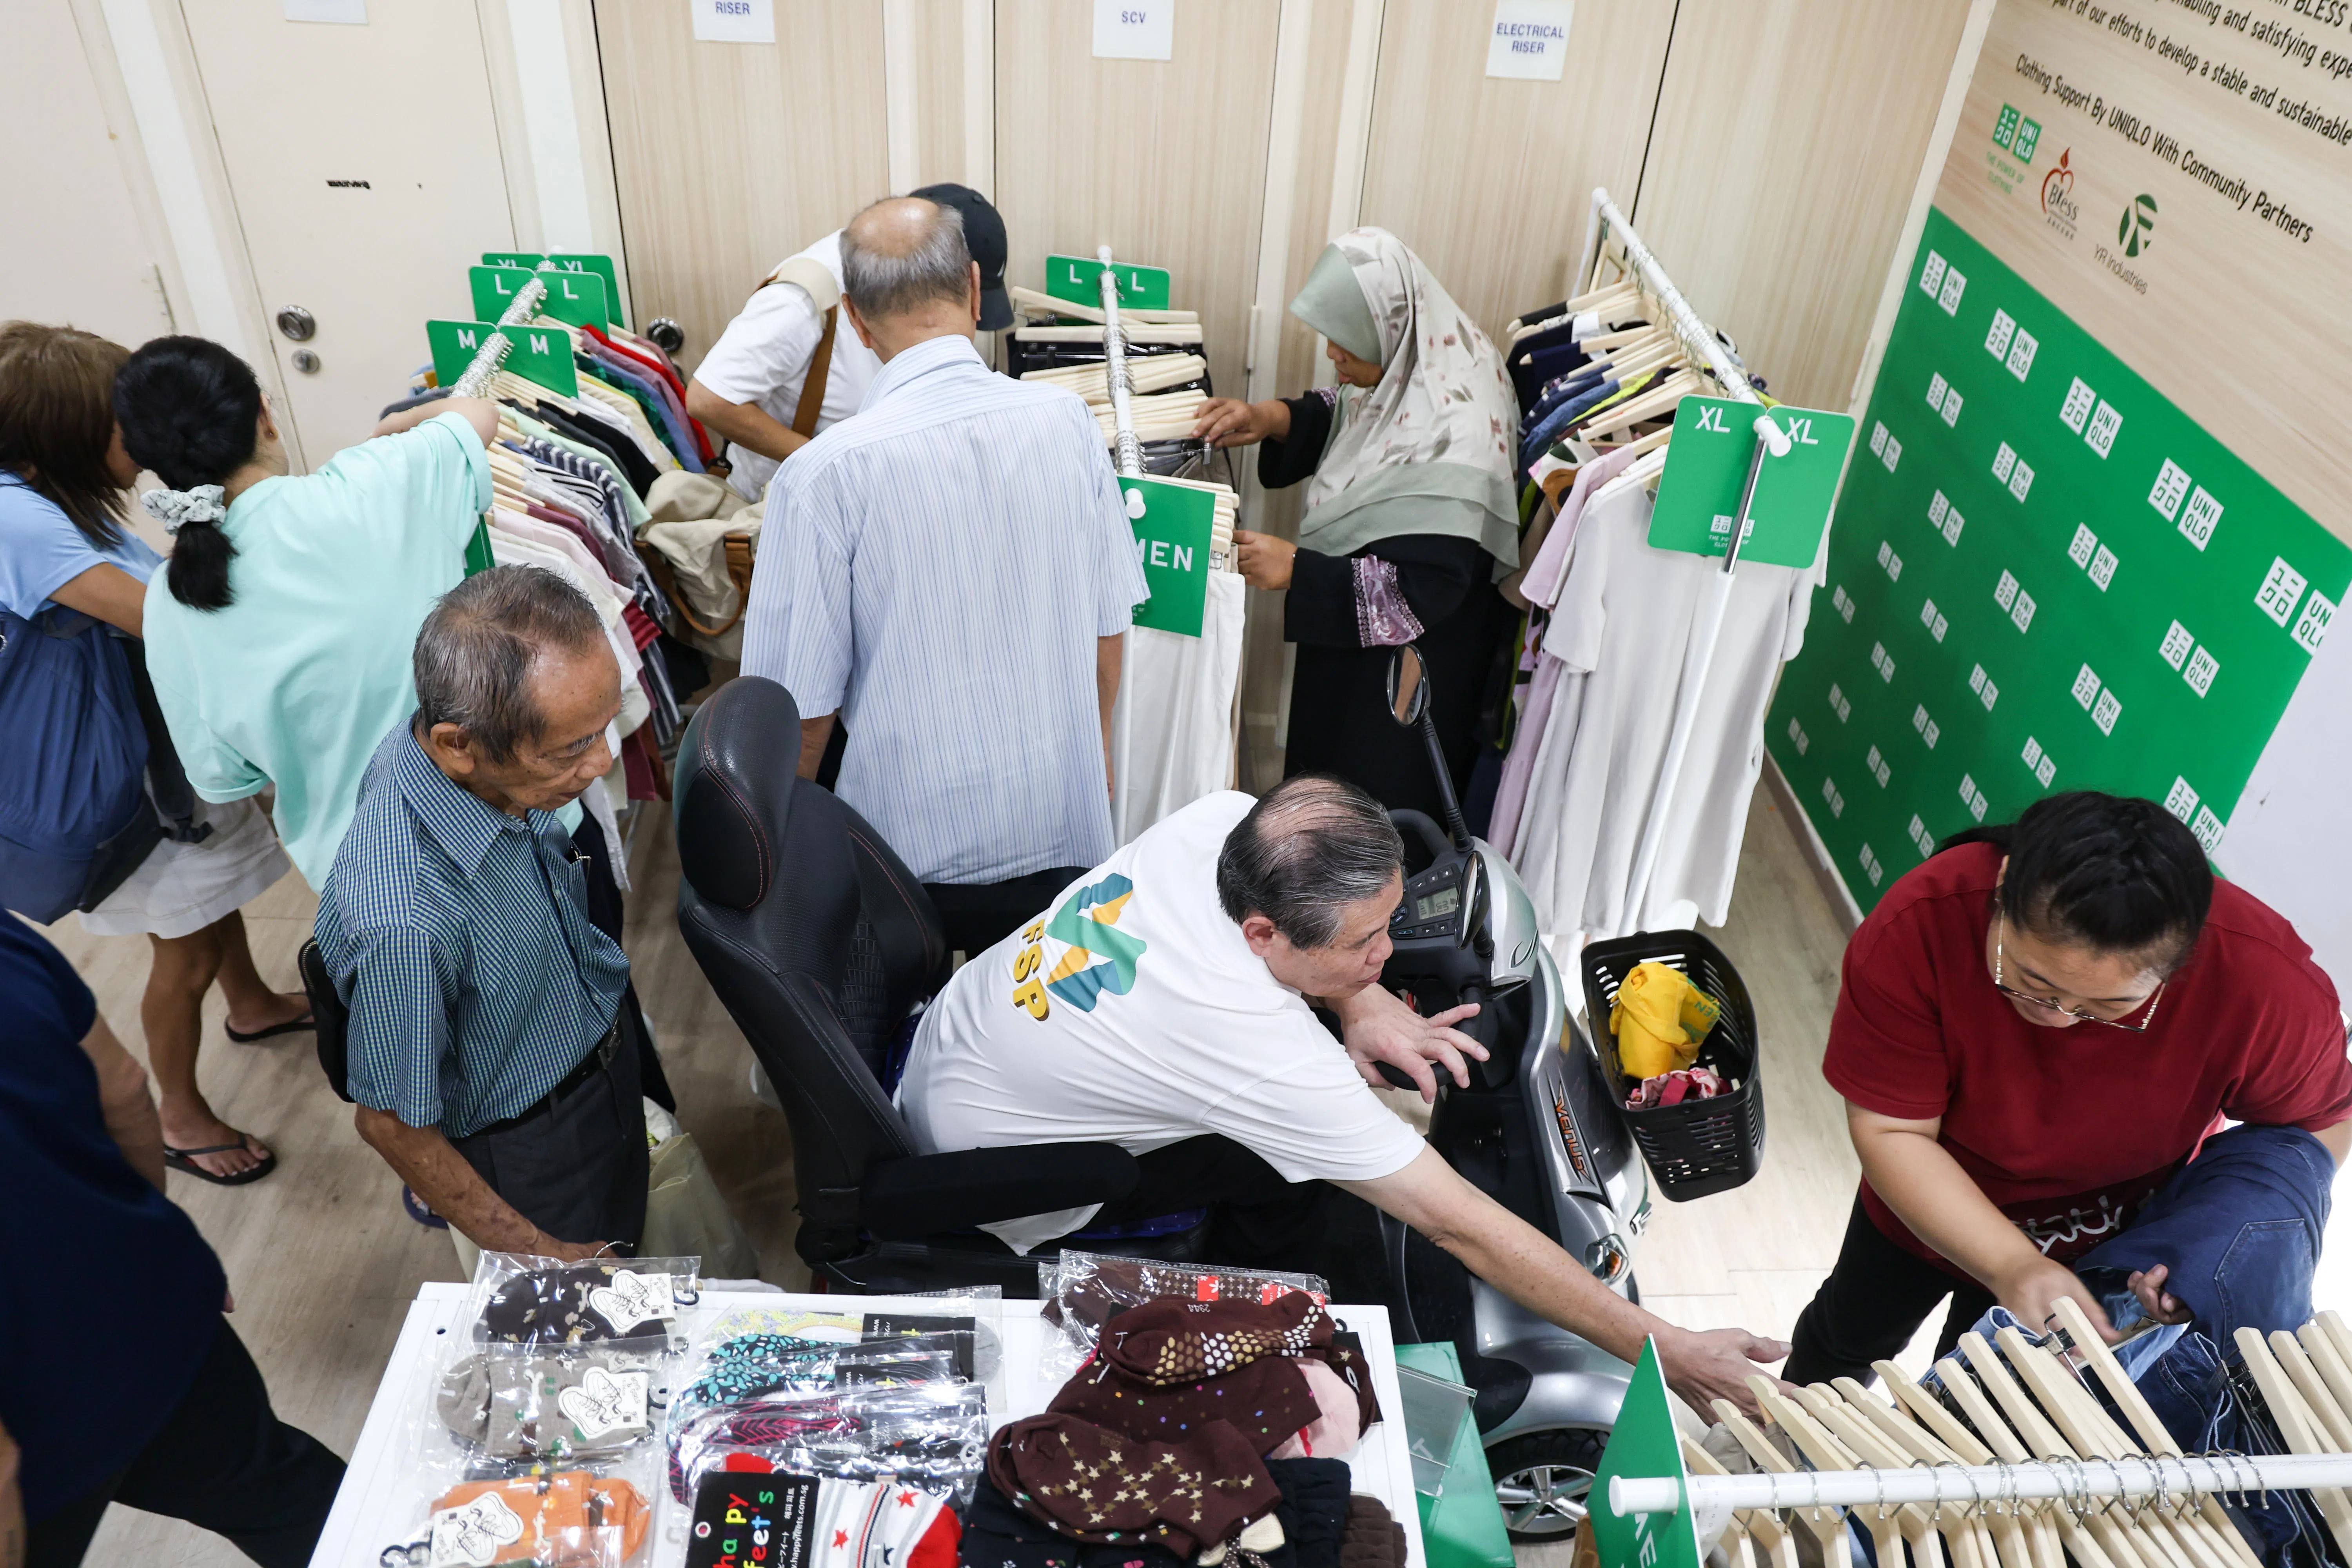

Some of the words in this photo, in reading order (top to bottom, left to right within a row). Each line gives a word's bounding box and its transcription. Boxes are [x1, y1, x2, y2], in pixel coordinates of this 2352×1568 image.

[715, 1, 750, 15] RISER
[1122, 11, 1146, 23] SCV
[1496, 23, 1564, 38] ELECTRICAL
[2223, 10, 2252, 31] and
[2250, 20, 2318, 67] satisfying
[1512, 40, 1544, 53] RISER
[2076, 0, 2090, 16] of
[2089, 6, 2108, 24] our
[2109, 13, 2143, 43] efforts
[2144, 27, 2156, 50] to
[2158, 35, 2198, 76] develop
[2200, 60, 2209, 76] a
[2211, 62, 2248, 95] stable
[2249, 87, 2279, 109] and
[2277, 100, 2352, 146] sustainable
[2016, 53, 2052, 94] Clothing
[2053, 75, 2092, 112] Support
[2091, 97, 2107, 125] By
[2109, 106, 2151, 146] UNIQLO
[2152, 131, 2179, 165] With
[2181, 149, 2252, 211] Community
[2252, 190, 2314, 243] Partners
[2048, 183, 2079, 221] Bless
[1069, 264, 1082, 284] L
[2094, 243, 2108, 265] YR
[2106, 254, 2148, 295] Industries
[494, 274, 512, 295] L
[562, 279, 579, 299] L
[1131, 272, 1145, 292] L
[457, 328, 477, 349] M
[529, 334, 549, 355] M
[1695, 405, 1731, 433] XL
[1786, 417, 1819, 445] XL
[2097, 407, 2116, 433] UNI
[2090, 425, 2110, 450] QLO
[2192, 494, 2216, 522] UNI
[2184, 512, 2208, 541] QLO
[2195, 652, 2213, 676] UNI
[2189, 666, 2207, 690] QLO
